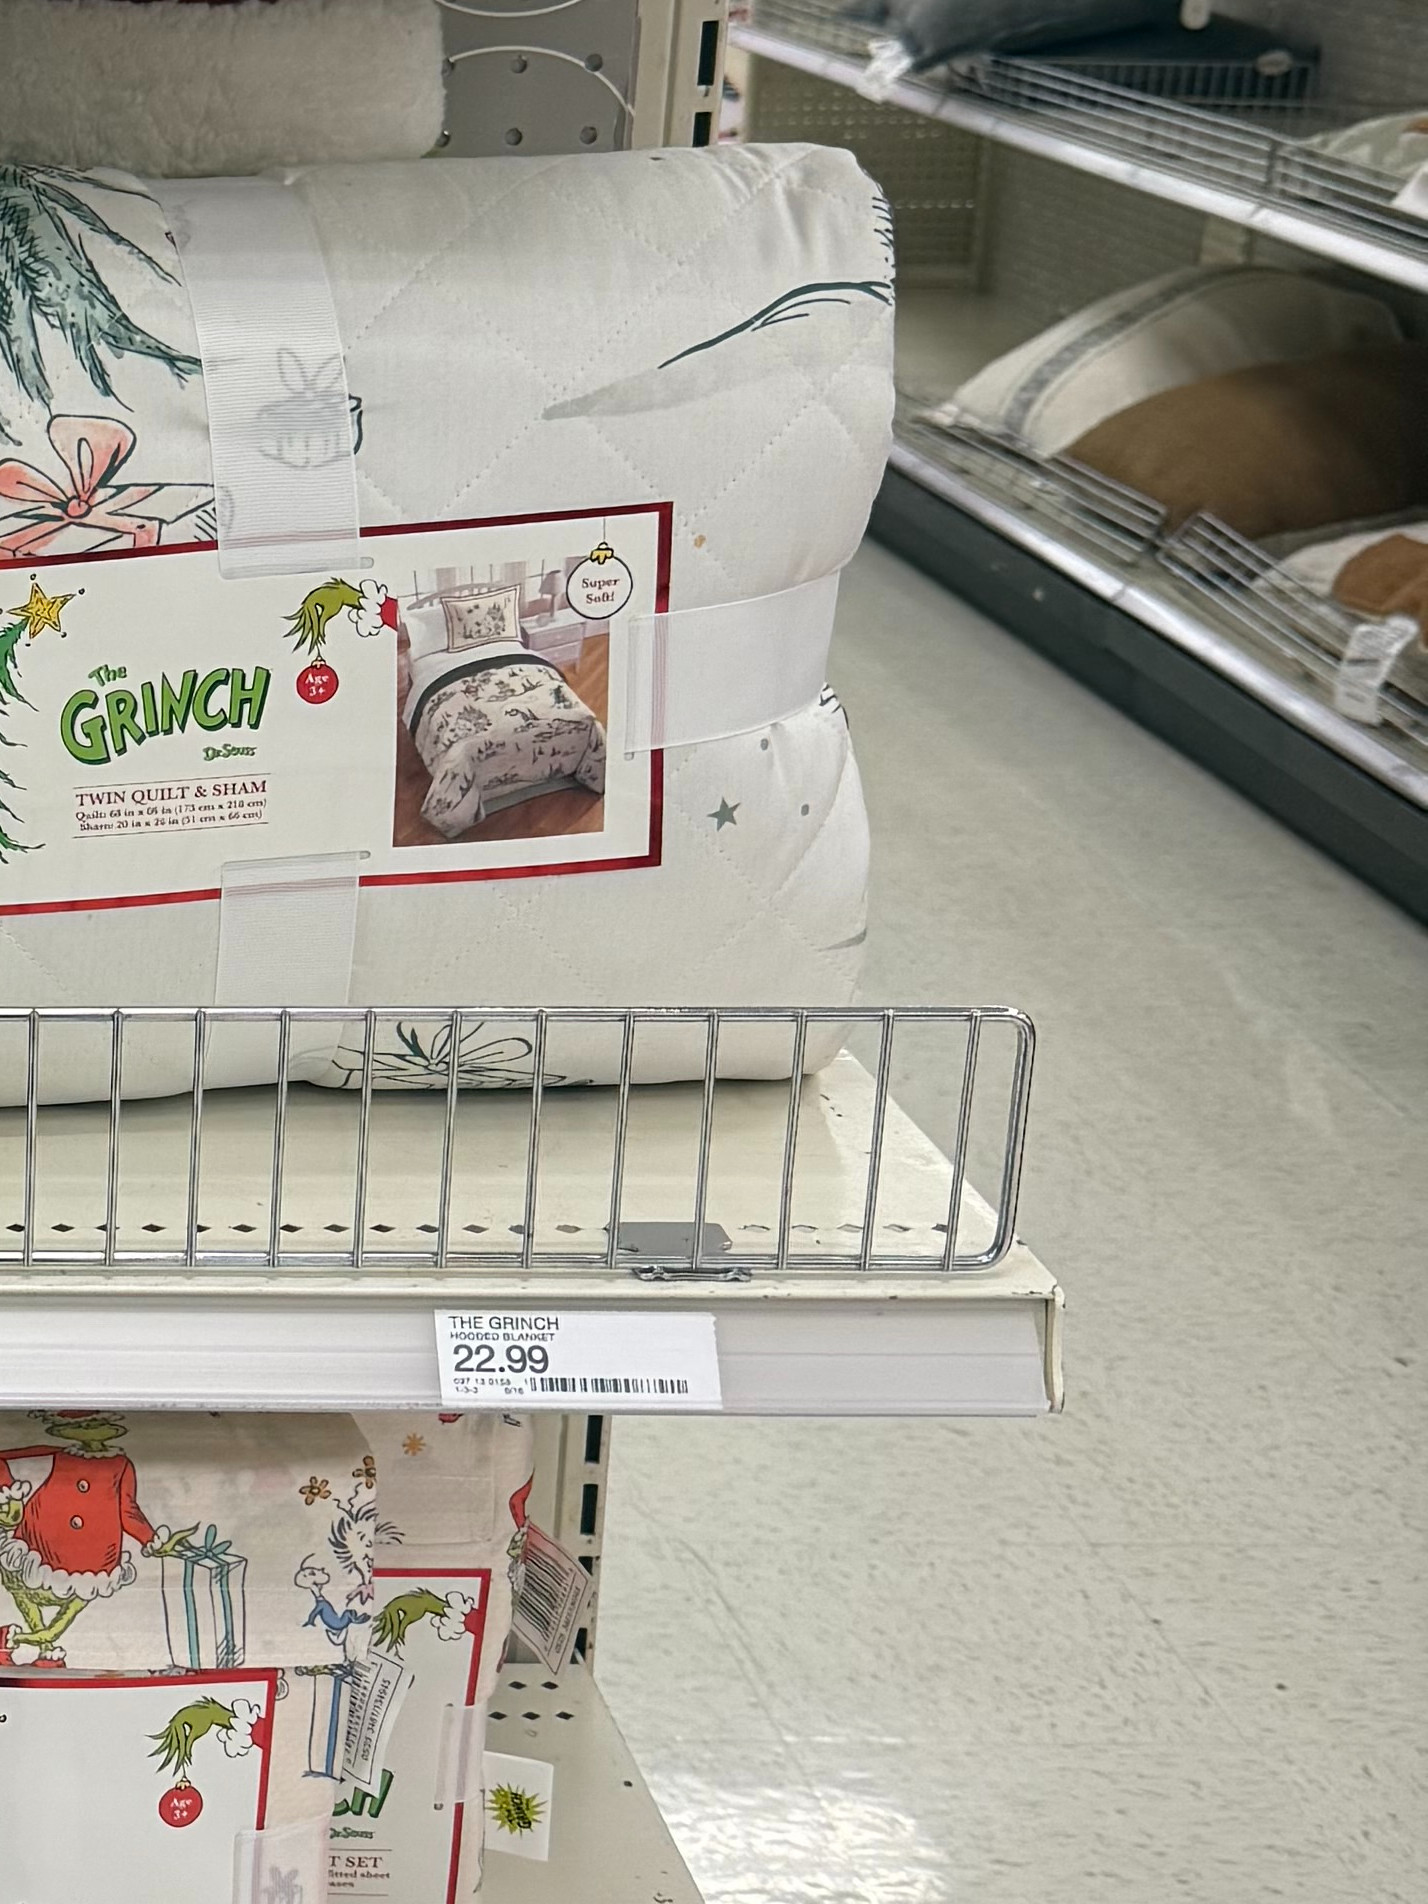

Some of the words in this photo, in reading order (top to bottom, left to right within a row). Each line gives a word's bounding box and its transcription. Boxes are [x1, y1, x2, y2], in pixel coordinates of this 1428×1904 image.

[582, 578, 620, 589] Super
[586, 591, 614, 604] Soft!
[88, 664, 127, 687] The
[304, 673, 329, 685] Age
[60, 666, 272, 765] GRINCH
[76, 790, 126, 807] TWIN
[131, 786, 190, 806] QUILT
[194, 785, 207, 798] &
[212, 780, 266, 796] SHAM
[448, 1316, 483, 1329] THE
[488, 1317, 559, 1330] GRINCH
[503, 1333, 556, 1341] BLANKET
[453, 1345, 549, 1373] 22.99
[170, 1797, 192, 1809] Age
[346, 1856, 383, 1869] SET
